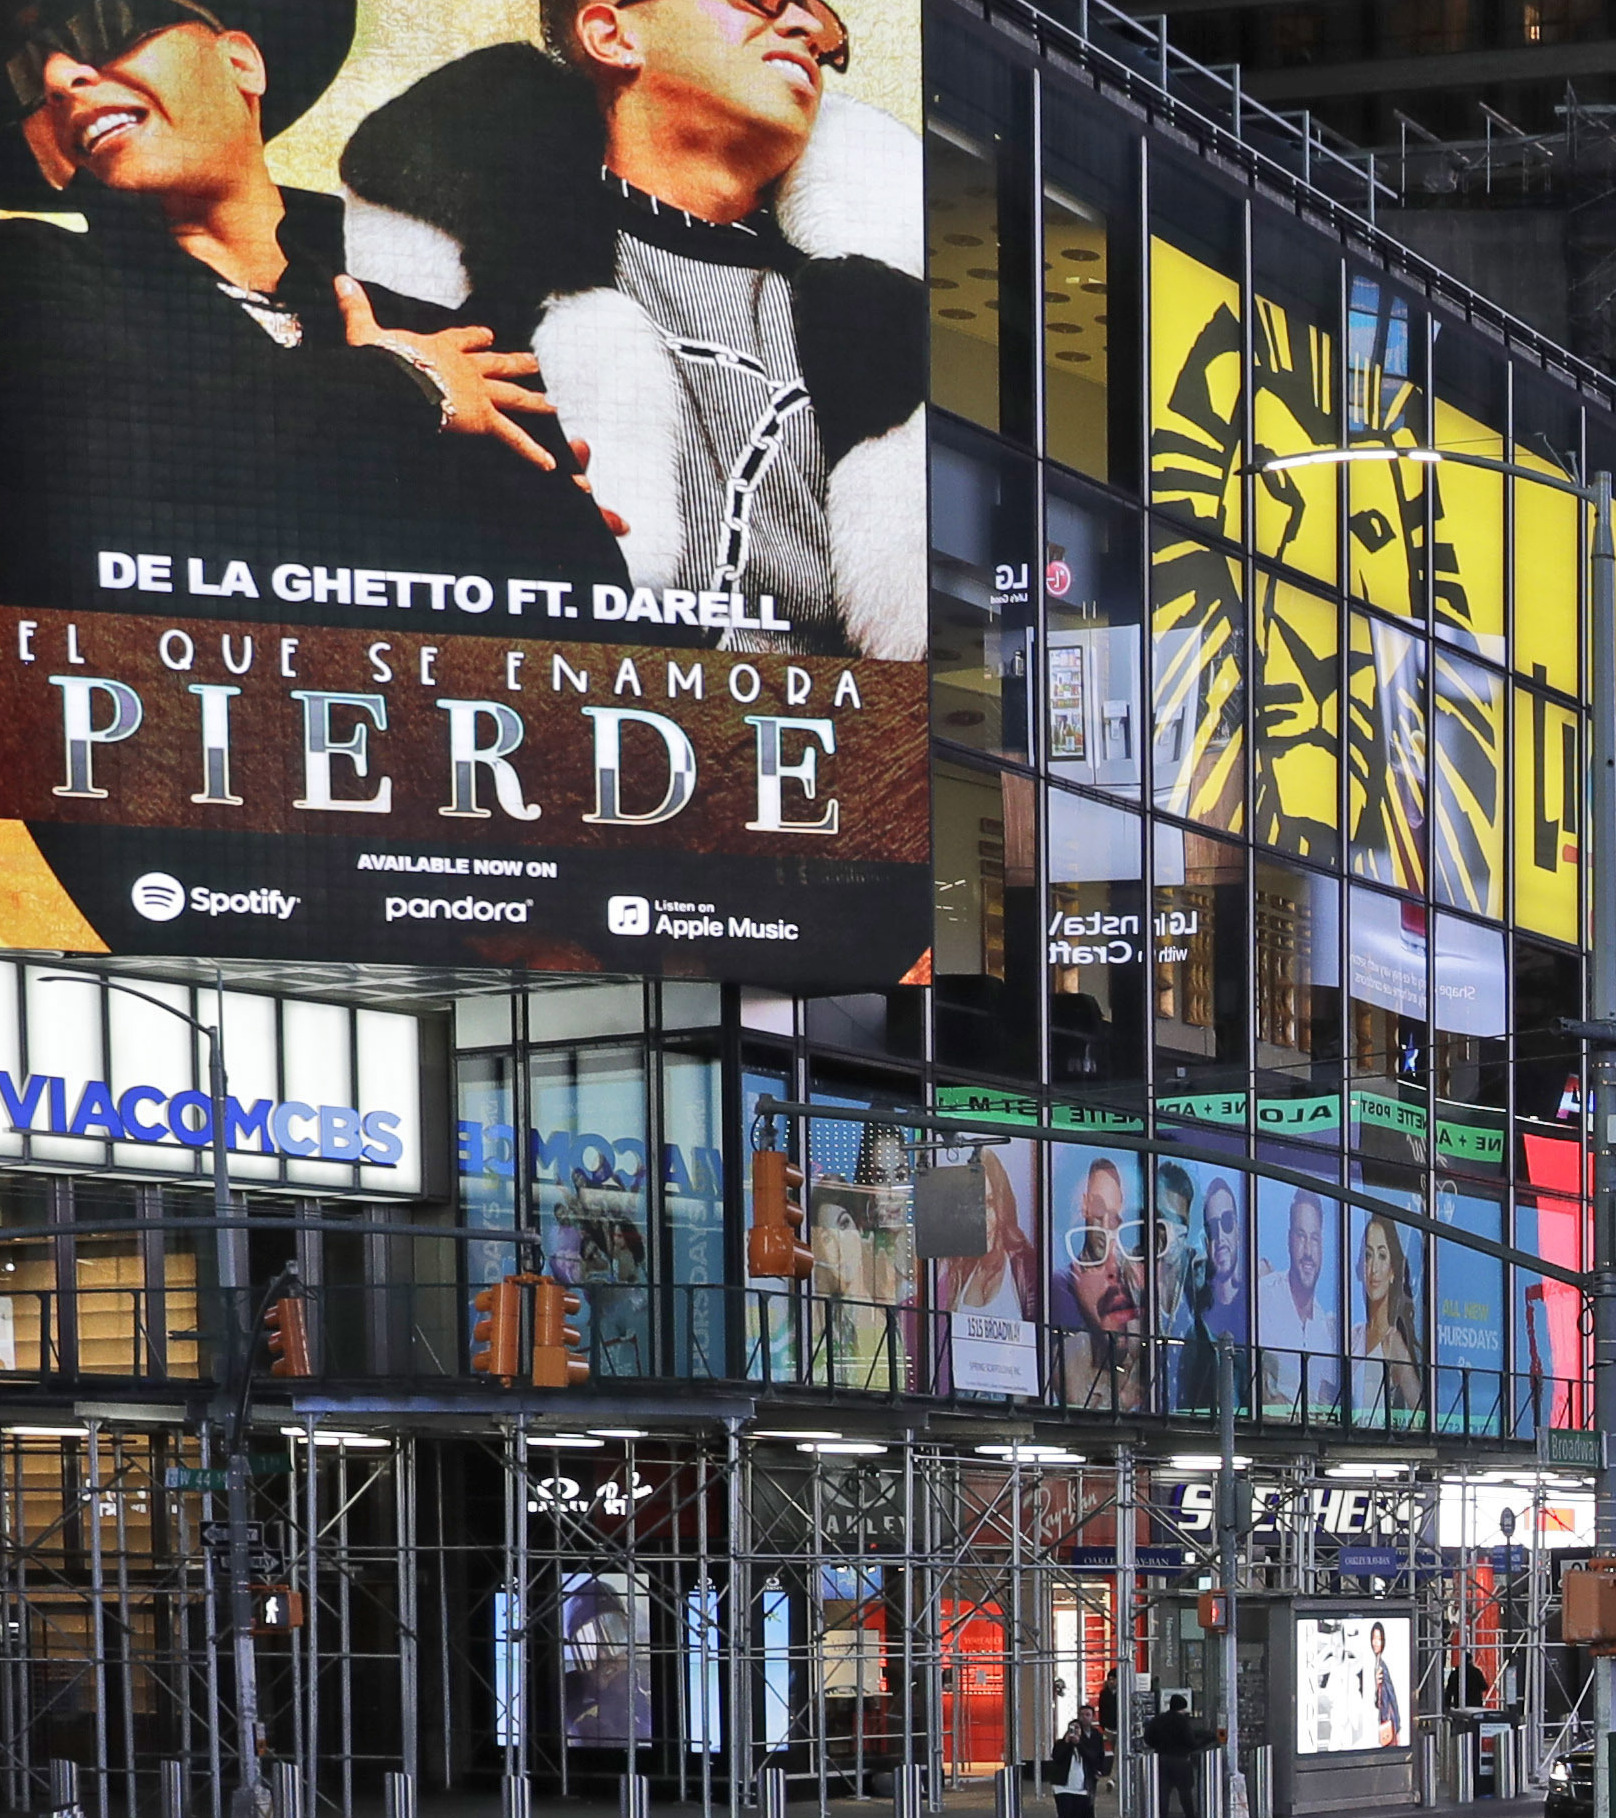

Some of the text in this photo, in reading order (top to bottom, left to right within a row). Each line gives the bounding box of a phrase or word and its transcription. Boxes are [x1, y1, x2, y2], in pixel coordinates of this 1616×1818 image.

[98, 551, 791, 631] DE LA GHETTO FT. DARELL
[18, 620, 862, 710] EL QUE SE ENAMORA
[49, 675, 840, 835] PIERDE
[357, 853, 558, 878] AVAILABLE NOW ON
[190, 886, 296, 920] Spotify
[386, 894, 529, 922] pandora
[655, 900, 715, 914] Listen on
[655, 914, 800, 941] Apple Music
[0, 1070, 404, 1166] VIACOMCBS
[1442, 1299, 1492, 1322] ALL NEW
[966, 1317, 1021, 1343] 1515 BROADWAY
[1551, 1433, 1601, 1465] Broadway
[1177, 1483, 1427, 1536] SECHERS
[1134, 1556, 1170, 1567] AY-BAN
